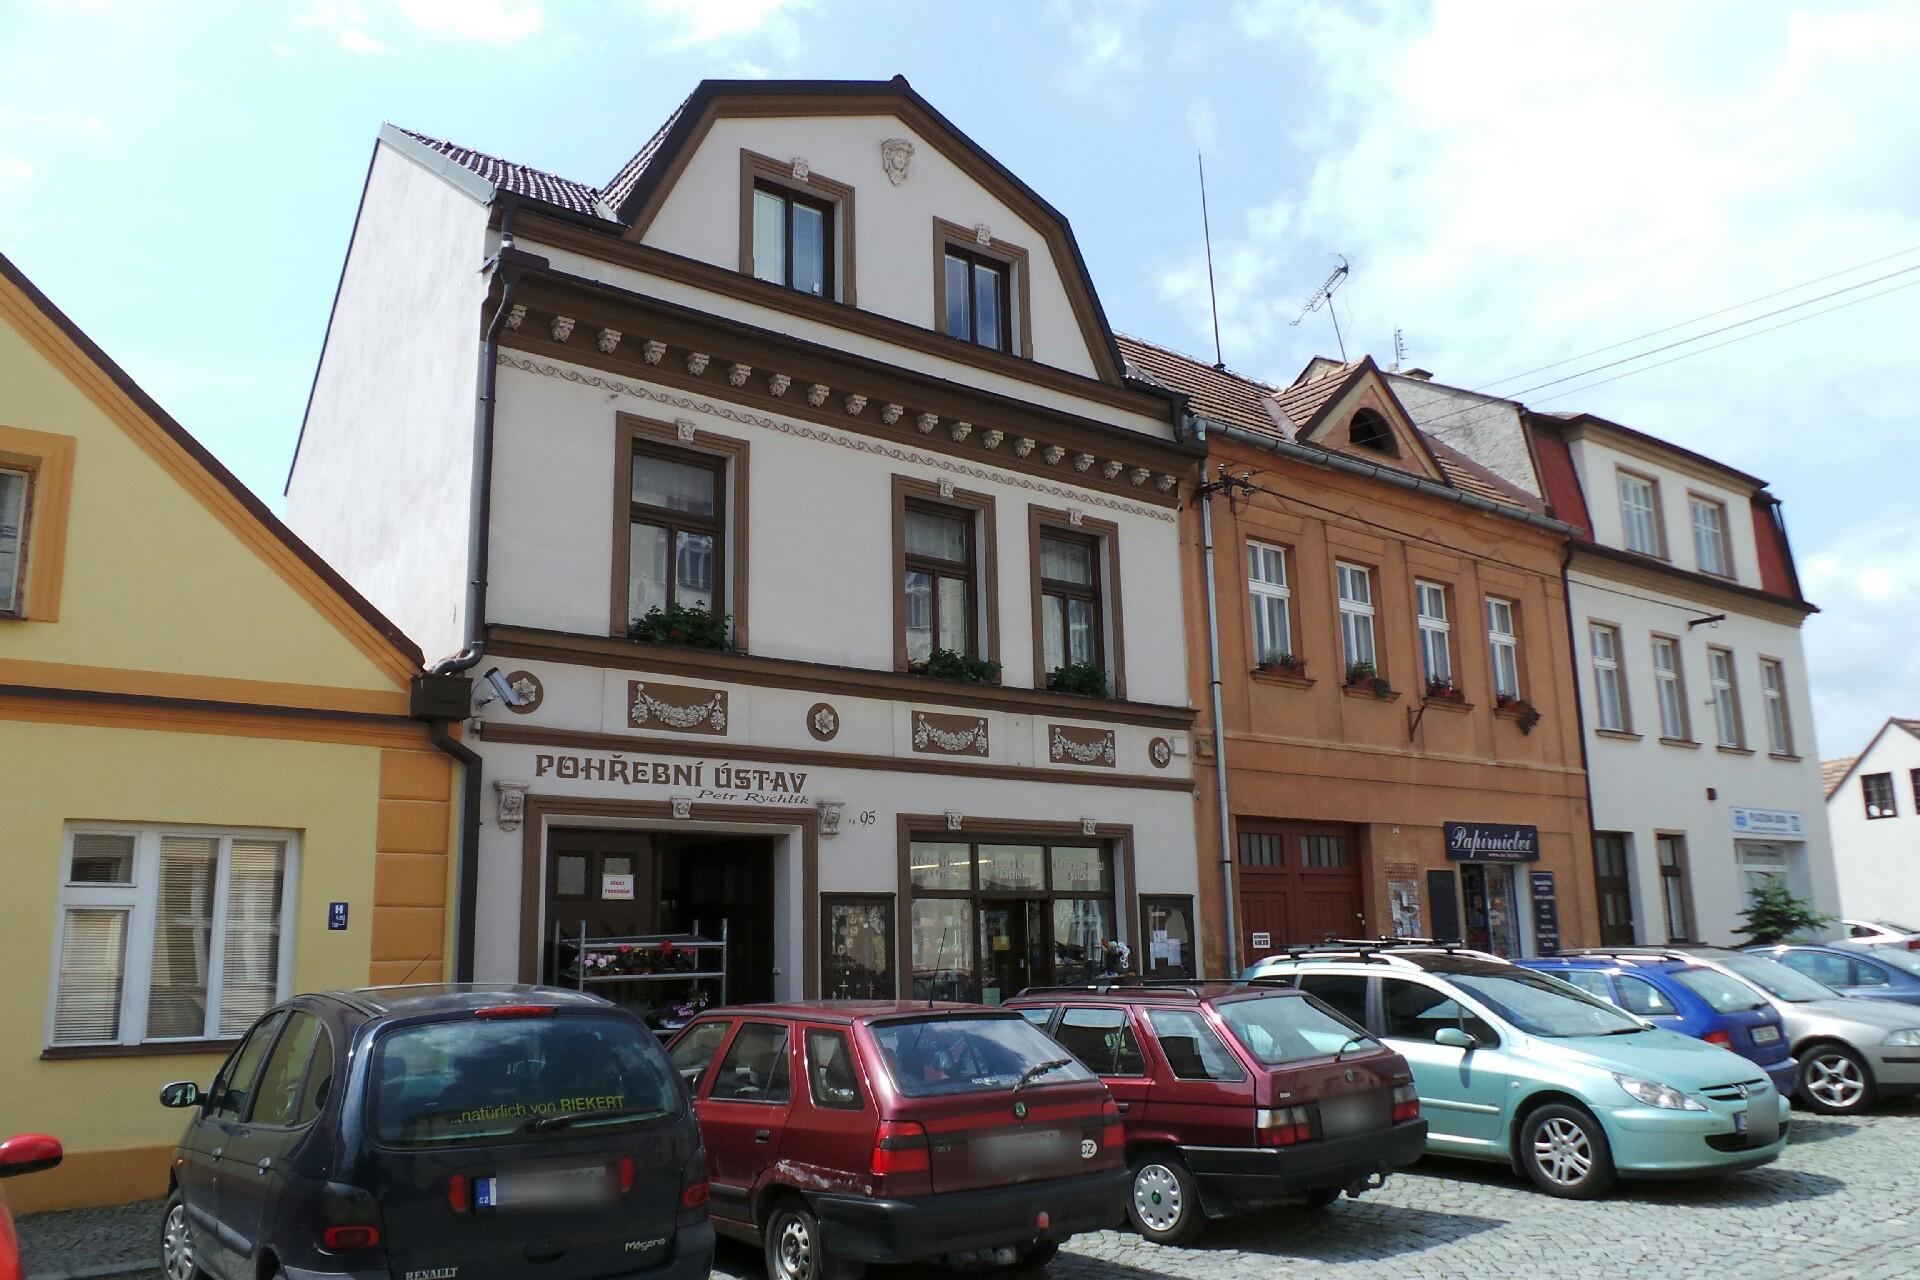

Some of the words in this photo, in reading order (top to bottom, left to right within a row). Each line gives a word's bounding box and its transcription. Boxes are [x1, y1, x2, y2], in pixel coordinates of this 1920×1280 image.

[535, 754, 704, 787] POHŘEBNÍ
[714, 763, 808, 793] ÚSTAV
[696, 789, 738, 801] Petr
[744, 792, 809, 804] Rychlík
[860, 810, 876, 827] 95
[1451, 826, 1533, 858] Papírnictví
[335, 904, 344, 914] H
[530, 1102, 556, 1114] von
[560, 1095, 625, 1112] RIEKERT
[405, 1267, 458, 1280] RENAULT
